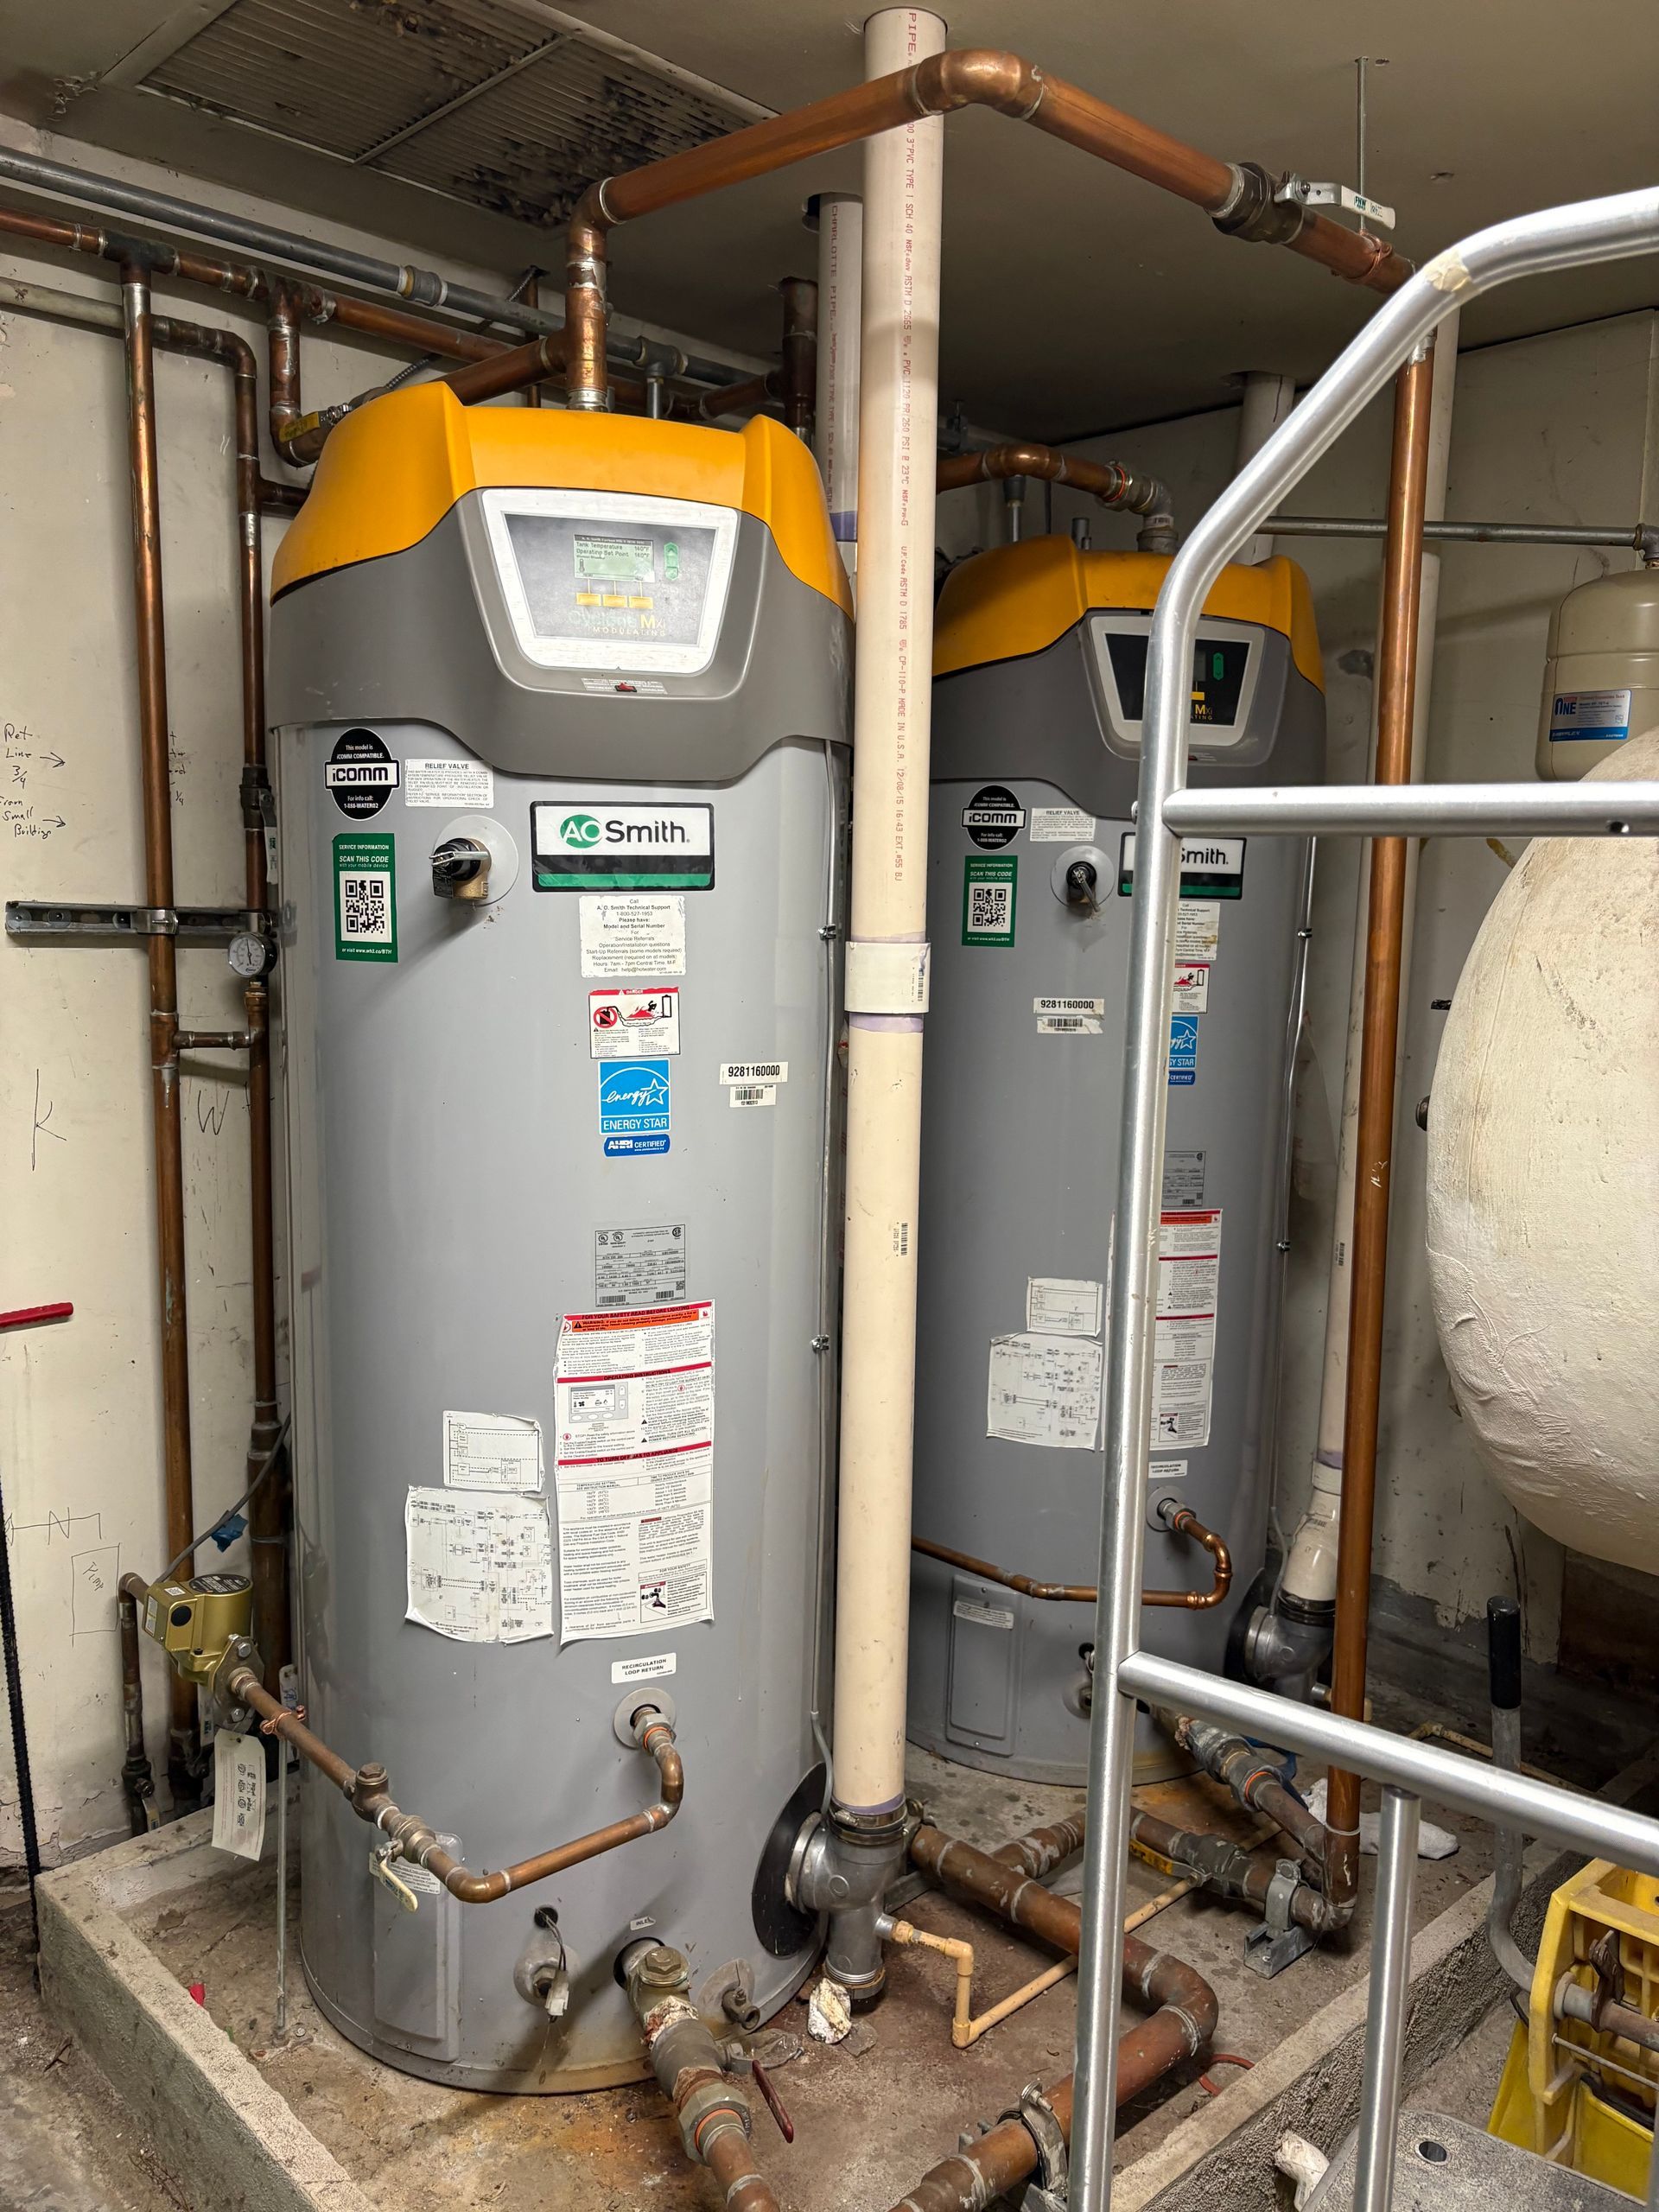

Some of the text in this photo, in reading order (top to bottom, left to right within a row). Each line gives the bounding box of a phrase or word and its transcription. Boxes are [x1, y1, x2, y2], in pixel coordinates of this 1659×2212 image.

[908, 12, 917, 53] PIPE
[906, 168, 914, 189] TYPE
[906, 202, 914, 220] SCH
[905, 222, 913, 234] 40
[904, 274, 912, 296] ASTM
[903, 309, 912, 330] 2665
[901, 435, 910, 451] PSI
[576, 548, 603, 556] Operating
[591, 543, 623, 552] Temperature
[593, 626, 666, 637] MODULATING
[898, 722, 905, 732] IN
[2, 805, 34, 822] Small
[605, 820, 686, 843] Smith
[1040, 1000, 1095, 1009] 9281160000
[728, 1065, 780, 1077] 9281160000
[602, 1087, 648, 1106] energy
[603, 1116, 668, 1131] ENERGY STAR
[607, 1140, 633, 1150] AHRI
[621, 1658, 667, 1670] RECIRCULATION
